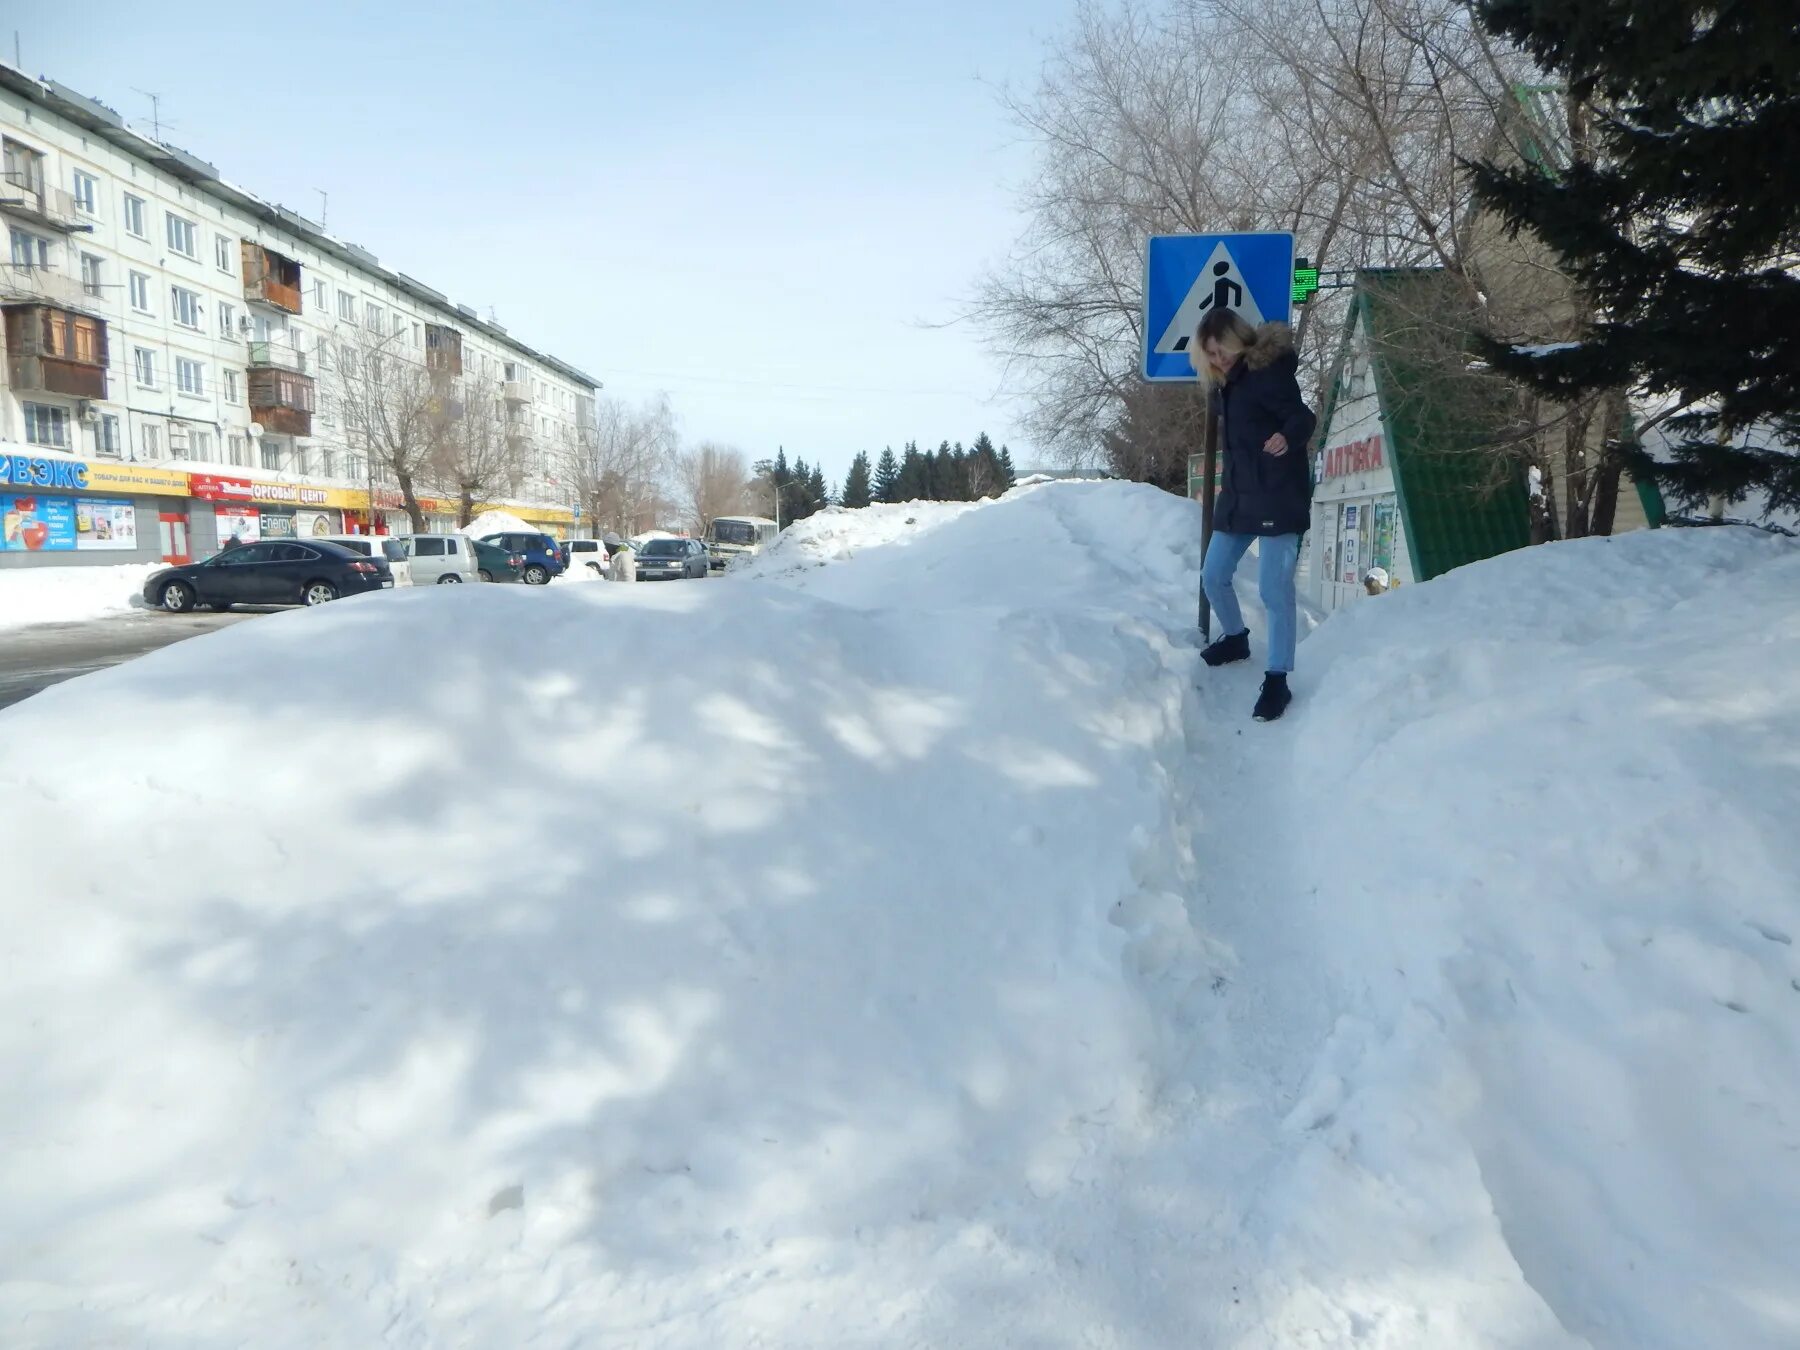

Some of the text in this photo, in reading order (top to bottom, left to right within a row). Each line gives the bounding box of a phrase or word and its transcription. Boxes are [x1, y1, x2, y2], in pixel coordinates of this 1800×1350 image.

[1325, 435, 1382, 477] АПТЕКА
[94, 473, 118, 481] ТОВАРЫ
[300, 488, 328, 503] ЦЕНТР
[260, 513, 292, 533] Energy
